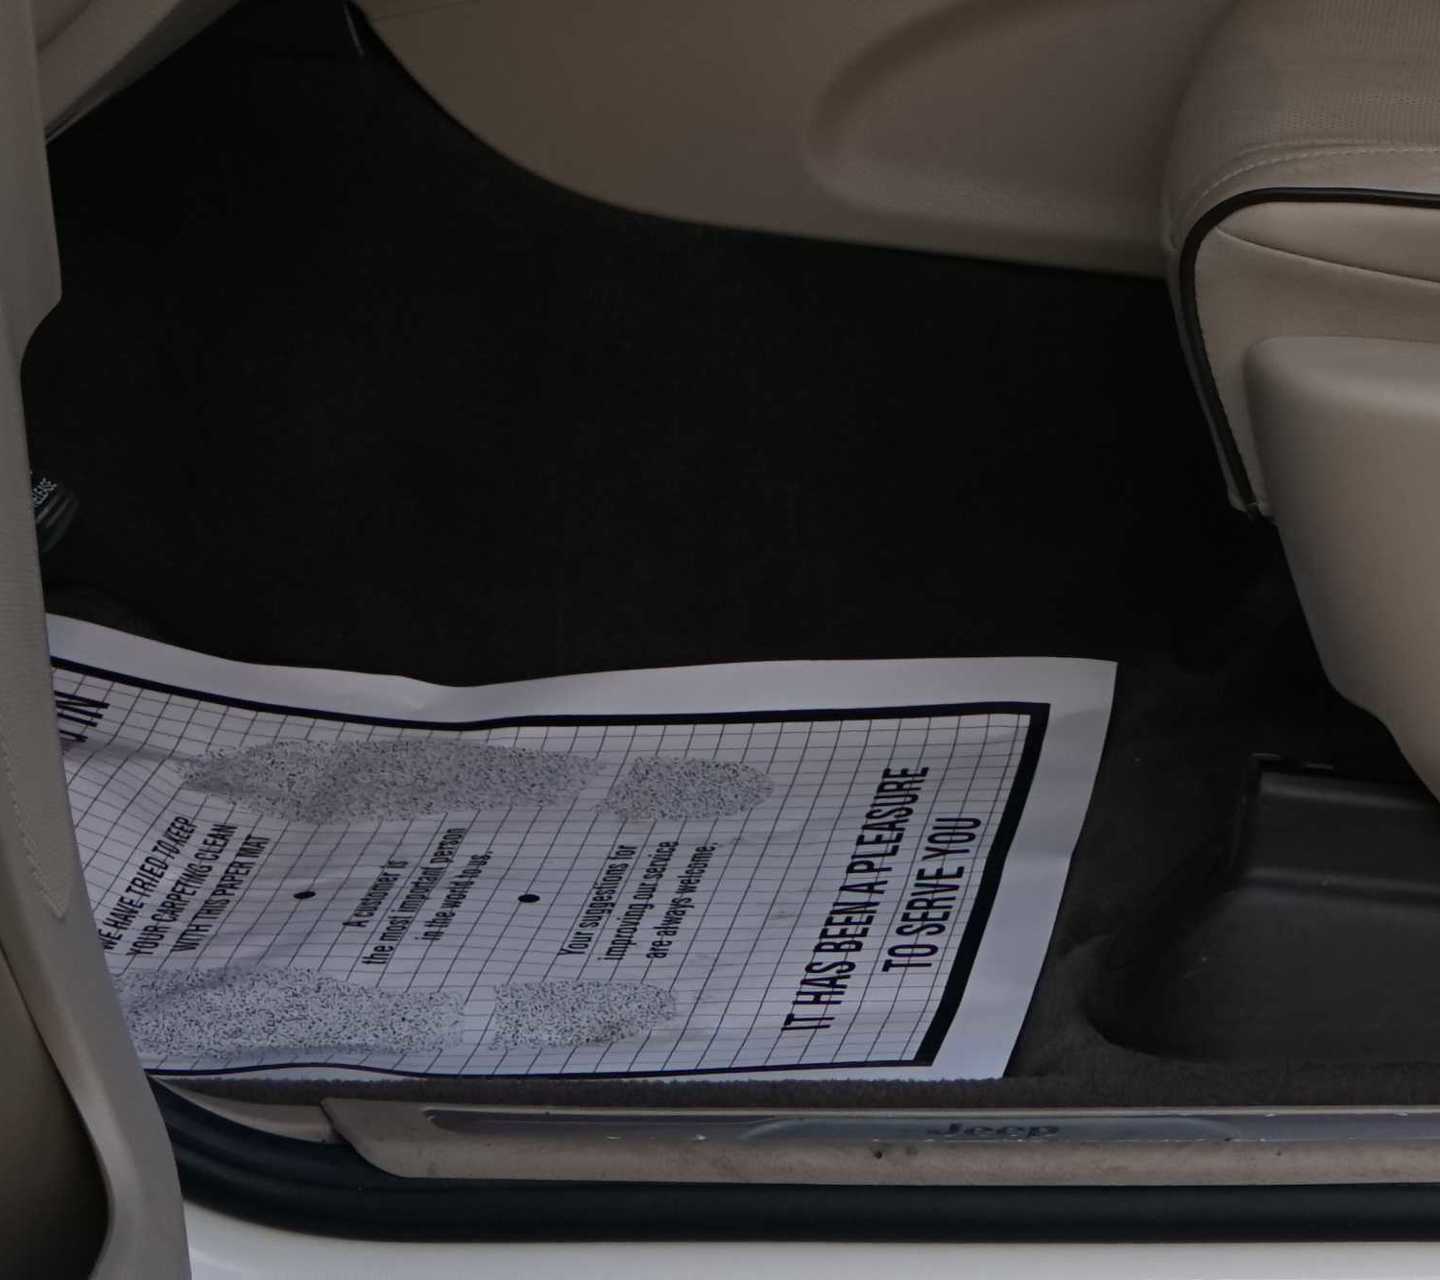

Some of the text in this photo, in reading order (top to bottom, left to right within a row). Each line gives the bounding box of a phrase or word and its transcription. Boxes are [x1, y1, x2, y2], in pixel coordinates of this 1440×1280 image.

[152, 839, 181, 860] TO
[162, 816, 198, 847] KEEP
[125, 856, 169, 898] TRIED
[125, 824, 238, 956] YOUR CARPETING CLEAN
[171, 834, 271, 952] WITH THIS PAPER MAT
[342, 859, 408, 928] A customer is
[455, 868, 482, 878] to
[102, 896, 145, 931] HAVE
[361, 827, 467, 965] the most important person
[440, 880, 475, 909] world
[559, 844, 638, 956] Your suggestions for
[597, 841, 679, 961] improving our service
[780, 766, 930, 1033] IT HAS BEEN A PLEASURE
[881, 817, 983, 973] TO SERVE YOU
[414, 931, 444, 941] in
[424, 911, 456, 928] the
[653, 896, 695, 937] always
[645, 939, 672, 959] are
[927, 1122, 1059, 1138] Jeep
